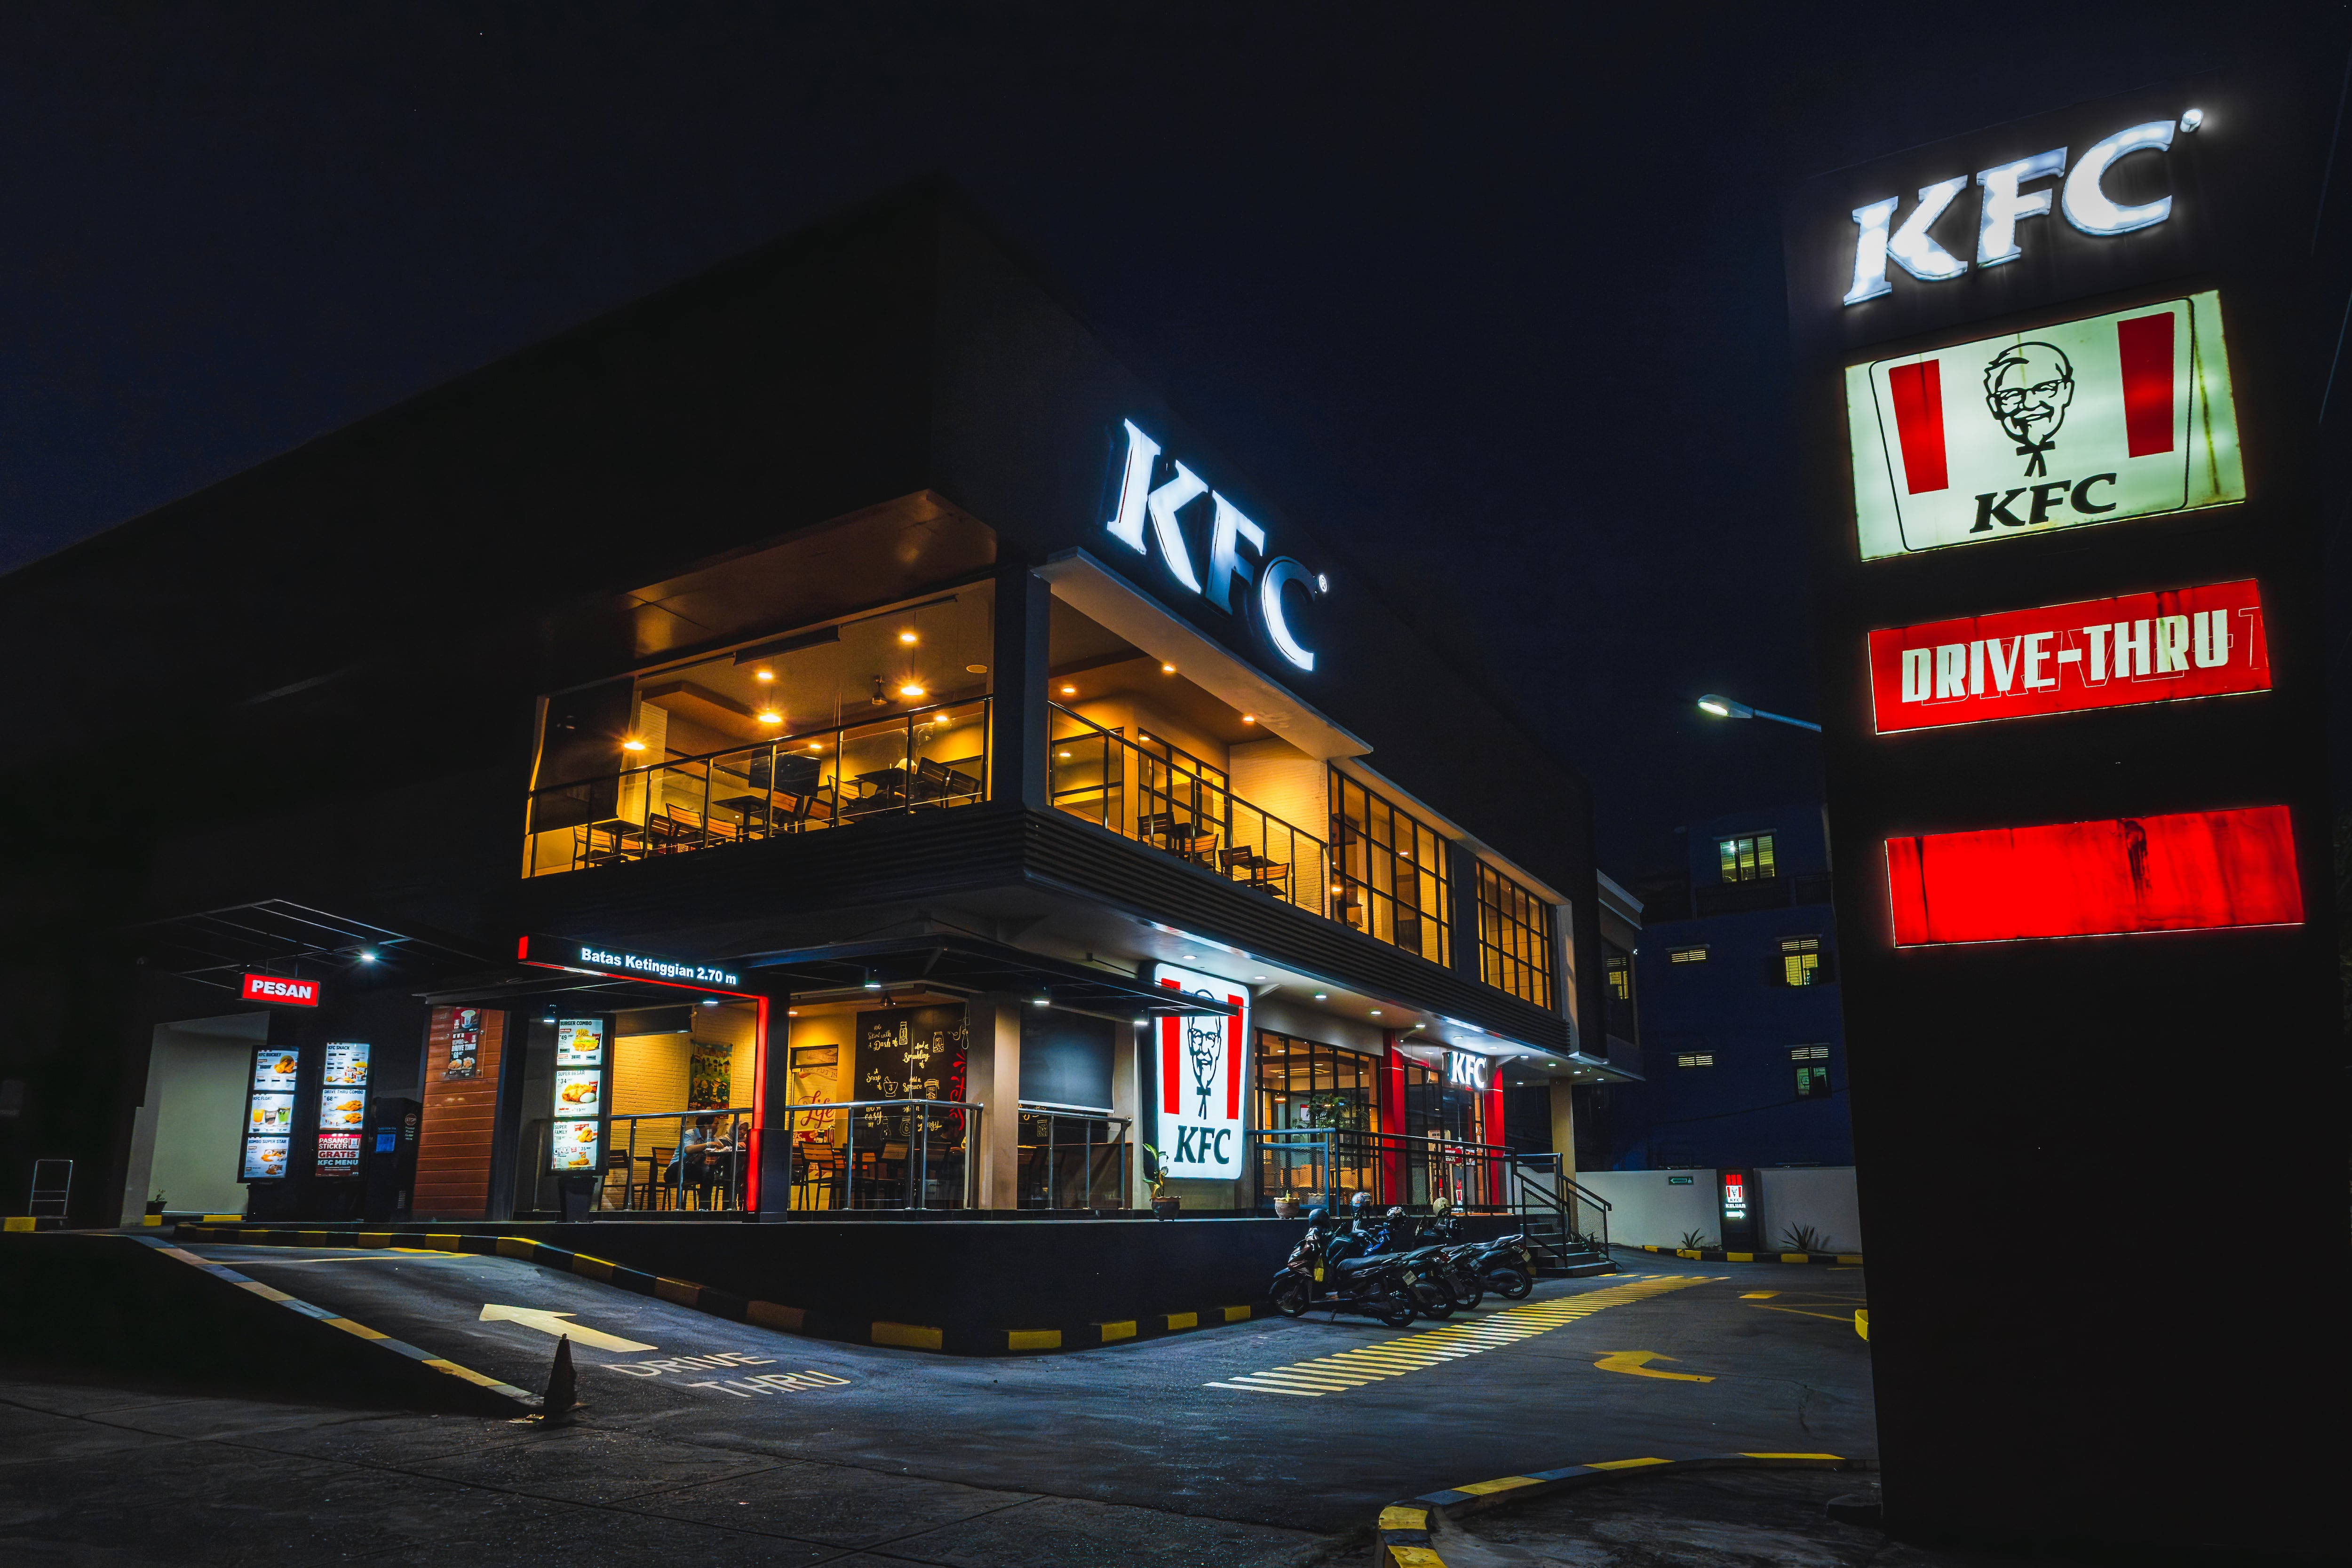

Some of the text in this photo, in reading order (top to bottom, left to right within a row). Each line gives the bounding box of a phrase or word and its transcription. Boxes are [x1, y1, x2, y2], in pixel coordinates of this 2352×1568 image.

[1843, 120, 2176, 306] KFC
[1970, 472, 2117, 534] KFC
[1107, 418, 1316, 672] KFC
[1902, 609, 2228, 703] DRIVE-THRU
[581, 948, 737, 985] Batas Ketinggian 2.70 m
[251, 980, 312, 999] PESAN
[873, 1040, 891, 1051] Dash
[892, 1037, 898, 1047] of
[1450, 1051, 1485, 1089] KFC
[1174, 1125, 1231, 1164] KFC
[599, 1352, 778, 1377] DRIVE
[687, 1370, 851, 1397] THRU
